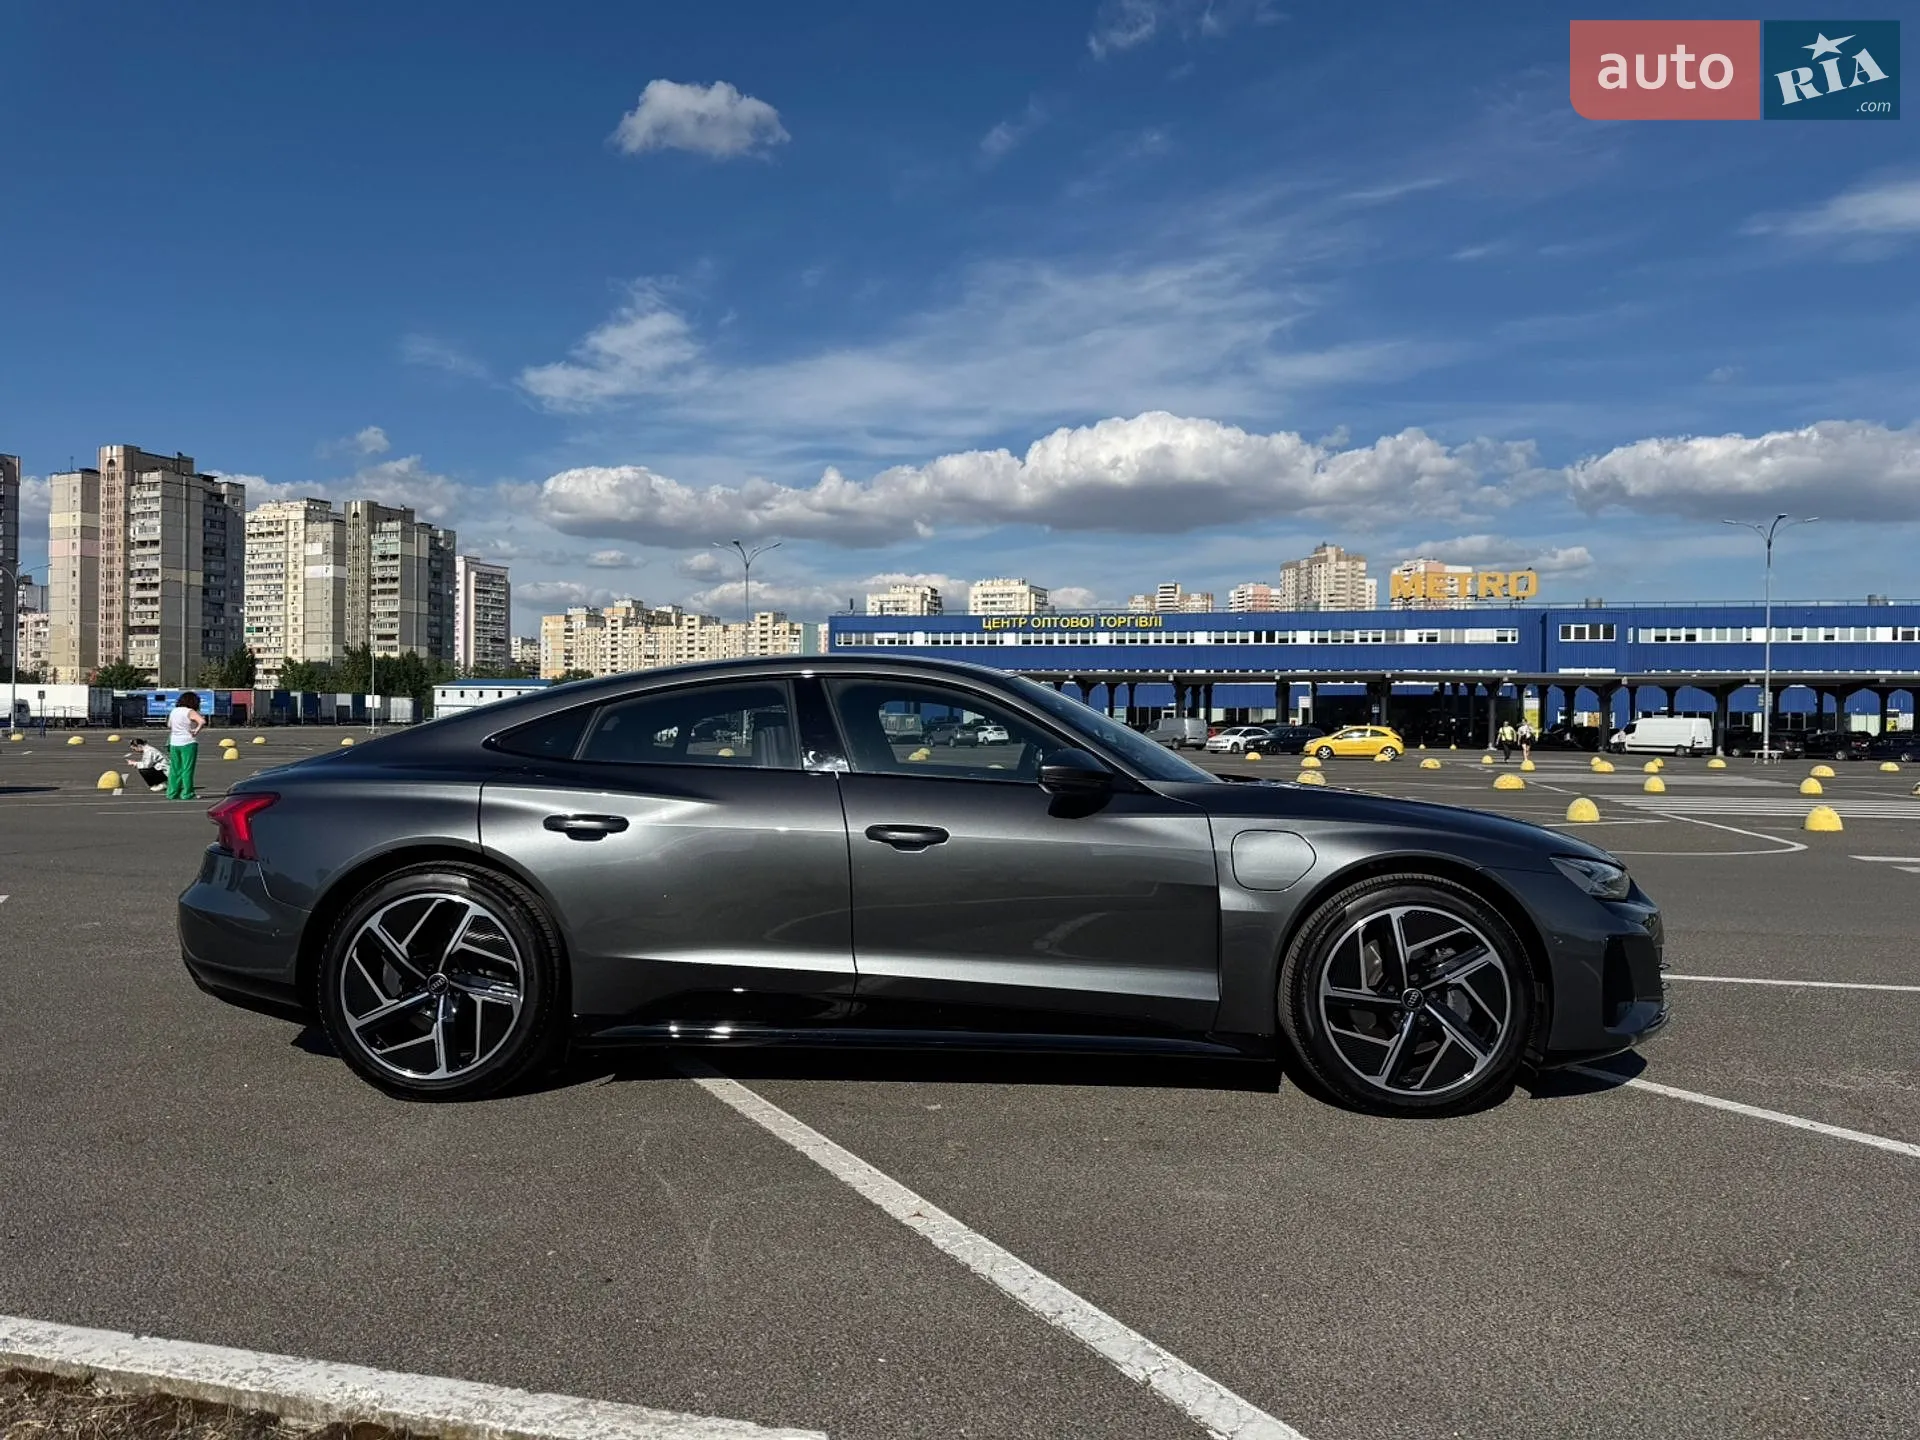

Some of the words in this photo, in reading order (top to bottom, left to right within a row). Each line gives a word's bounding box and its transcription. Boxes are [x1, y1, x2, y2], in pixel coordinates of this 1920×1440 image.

[1390, 571, 1538, 597] METRO
[982, 617, 1028, 631] ЦЕНТР
[1031, 615, 1094, 628] ОПТОВОЇ
[1100, 615, 1163, 628] ТОРГІВЛІ
